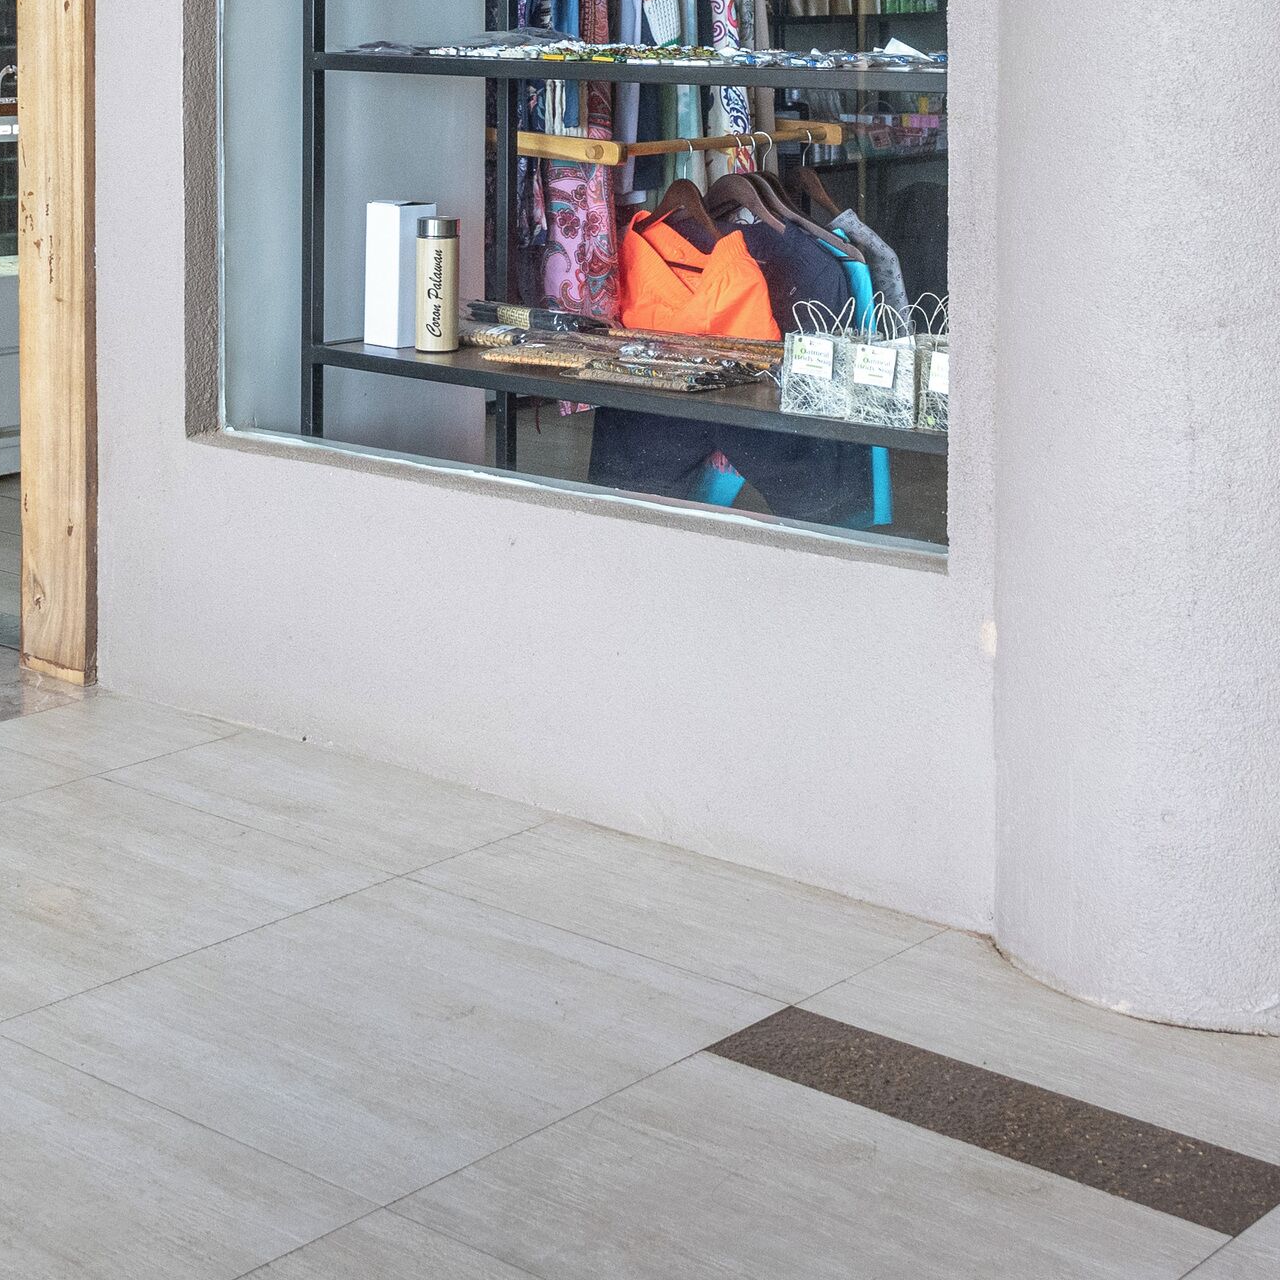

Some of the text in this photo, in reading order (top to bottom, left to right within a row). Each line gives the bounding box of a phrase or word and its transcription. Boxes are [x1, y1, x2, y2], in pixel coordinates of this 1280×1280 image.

[426, 249, 443, 337] Coron Palawan
[800, 347, 830, 359] Oatmeal
